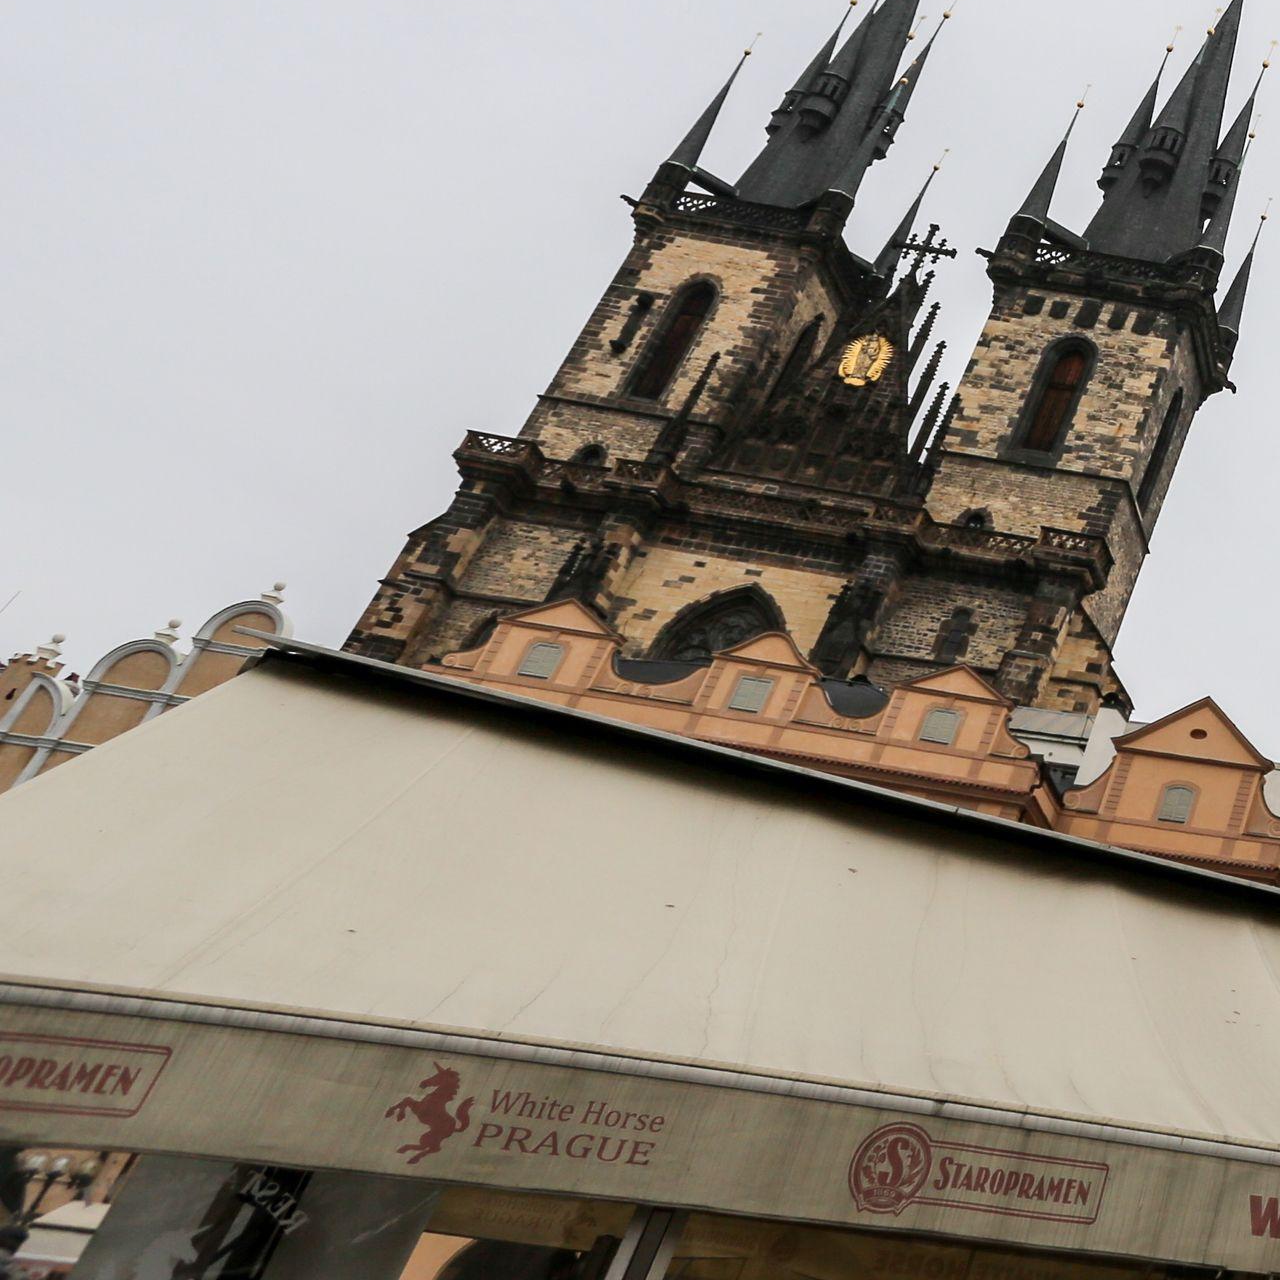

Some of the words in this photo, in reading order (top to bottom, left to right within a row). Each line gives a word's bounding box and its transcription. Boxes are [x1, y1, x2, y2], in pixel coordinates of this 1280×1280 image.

[489, 1088, 574, 1122] White
[580, 1100, 666, 1133] Horse
[472, 1123, 656, 1166] PRAGUE
[933, 1156, 1093, 1206] STAROPRAMEN
